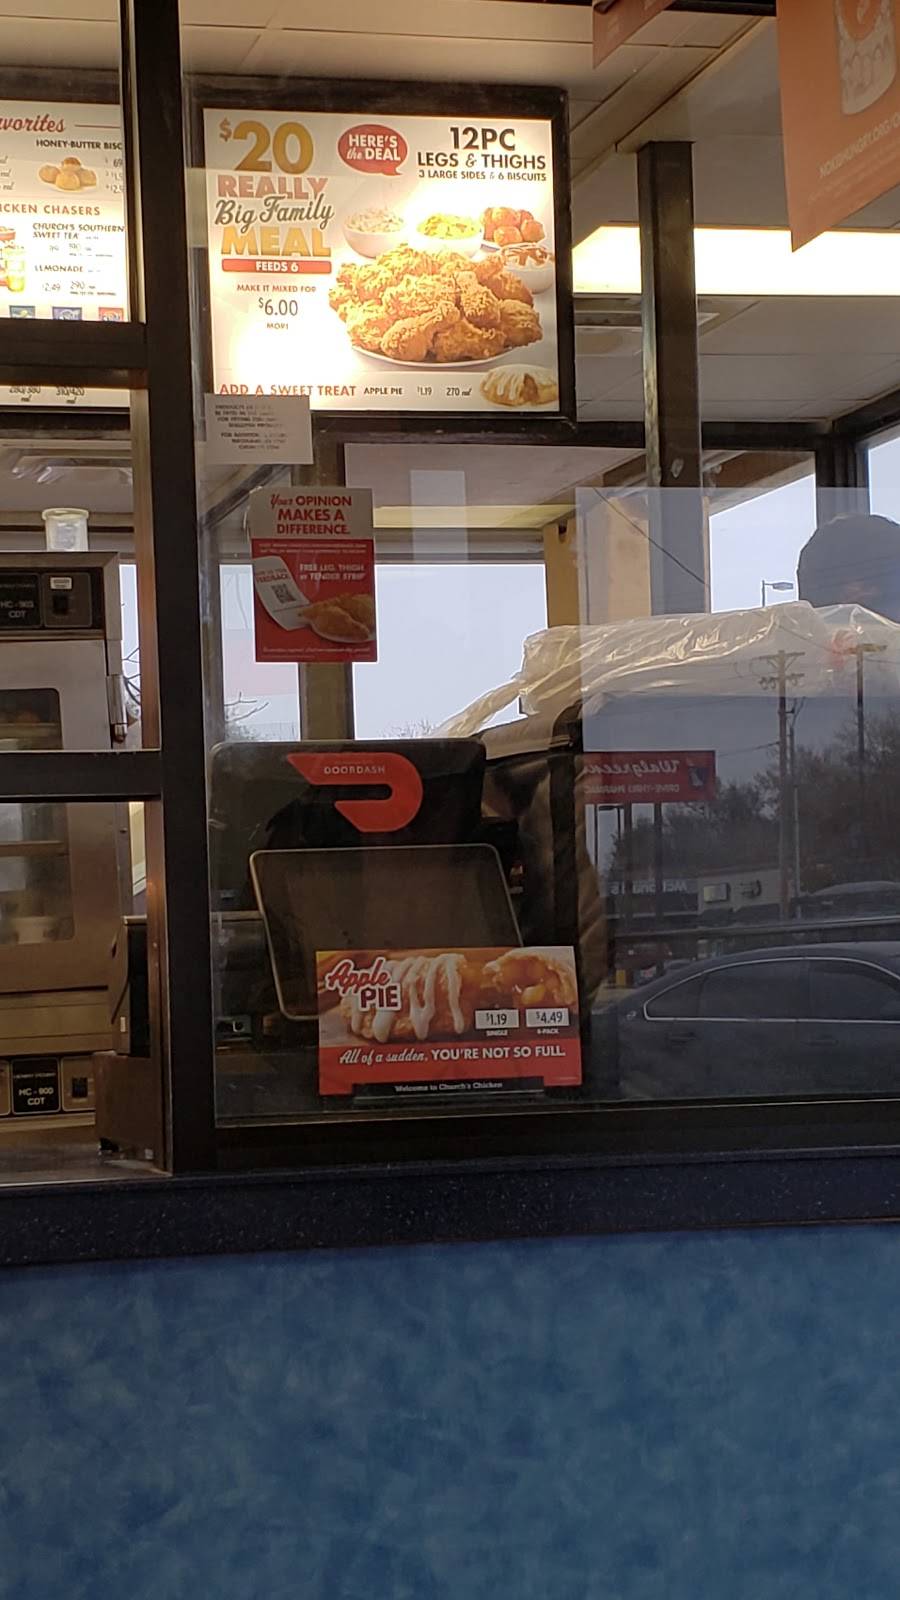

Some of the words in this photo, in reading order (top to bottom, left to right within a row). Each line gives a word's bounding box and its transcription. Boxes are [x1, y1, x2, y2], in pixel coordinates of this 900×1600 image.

[36, 139, 101, 150] HONEY-BUTTER
[348, 134, 398, 148] HERE'S
[450, 126, 516, 151] 12PC
[219, 118, 314, 175] $20
[346, 147, 363, 160] the
[364, 147, 401, 161] DEAL
[417, 151, 459, 168] LEGS
[465, 153, 478, 168] &
[481, 153, 546, 170] THIGHS
[418, 170, 425, 178] 3
[427, 170, 458, 180] LARGE
[461, 171, 486, 180] SIDES
[498, 171, 505, 181] 6
[507, 172, 547, 181] BISCUITS
[218, 174, 328, 200] REALLY
[43, 204, 101, 216] CHASERS
[215, 199, 257, 234] Big
[259, 193, 335, 230] Family
[33, 222, 75, 231] CHURCH'S
[79, 223, 125, 232] SOUTHERN
[33, 231, 60, 239] SWEET
[64, 232, 79, 240] TEA
[220, 226, 331, 257] MEAL
[34, 264, 83, 273] LEMONADE
[255, 261, 288, 272] FEEDS
[290, 261, 299, 272] 6
[237, 284, 260, 292] MAKE
[262, 284, 270, 292] IT
[272, 284, 298, 292] MIXED
[258, 297, 299, 316] $6.00
[220, 383, 249, 396] ADD
[255, 384, 264, 397] A
[270, 384, 313, 397] SWEET
[317, 385, 357, 397] TREAT
[363, 387, 388, 395] APPLE
[390, 387, 403, 395] PIE
[446, 387, 460, 396] 270
[270, 493, 294, 509] Your
[296, 495, 352, 506] OPINION
[278, 508, 331, 521] MAKES
[333, 508, 345, 521] A
[300, 563, 318, 571] FREE
[8, 610, 26, 618] CDT
[323, 766, 386, 775] DOORDASH
[326, 957, 391, 995] Apple
[360, 985, 398, 1009] PIE
[486, 1012, 508, 1026] $1.19
[535, 1011, 563, 1024] $4.49
[339, 1048, 361, 1064] All
[361, 1049, 375, 1066] of
[375, 1053, 384, 1063] a
[431, 1048, 480, 1061] YOU'RE
[482, 1047, 511, 1059] NOT
[513, 1046, 532, 1058] SO
[394, 1085, 428, 1093] Welcome
[438, 1082, 471, 1091] Church's
[472, 1081, 504, 1089] Chicken
[27, 1096, 46, 1106] CDT
